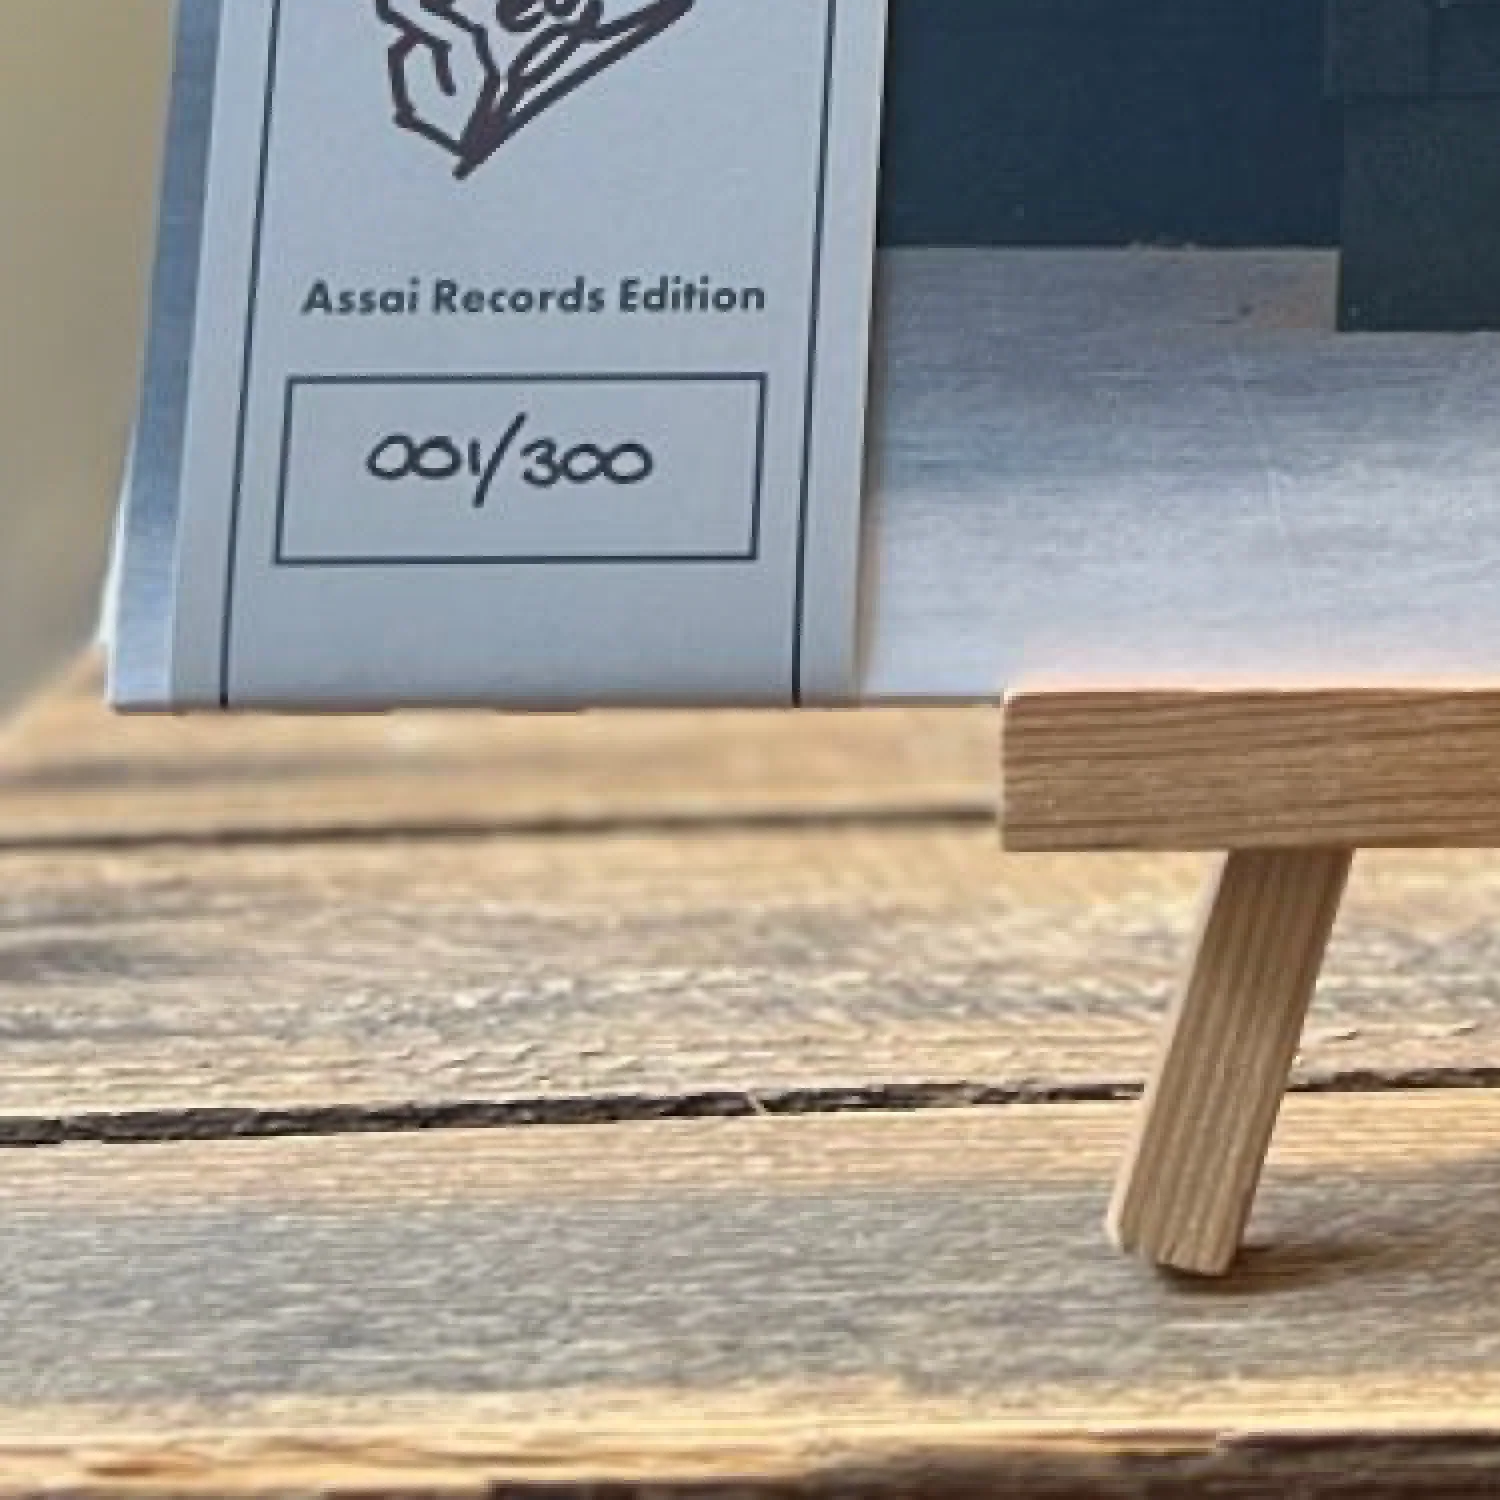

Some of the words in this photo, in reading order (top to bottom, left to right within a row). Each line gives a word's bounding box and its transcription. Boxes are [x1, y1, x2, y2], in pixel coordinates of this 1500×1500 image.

[301, 276, 421, 315] Assai
[431, 275, 605, 314] Records
[618, 274, 766, 313] Edition
[365, 411, 655, 509] 001/300
